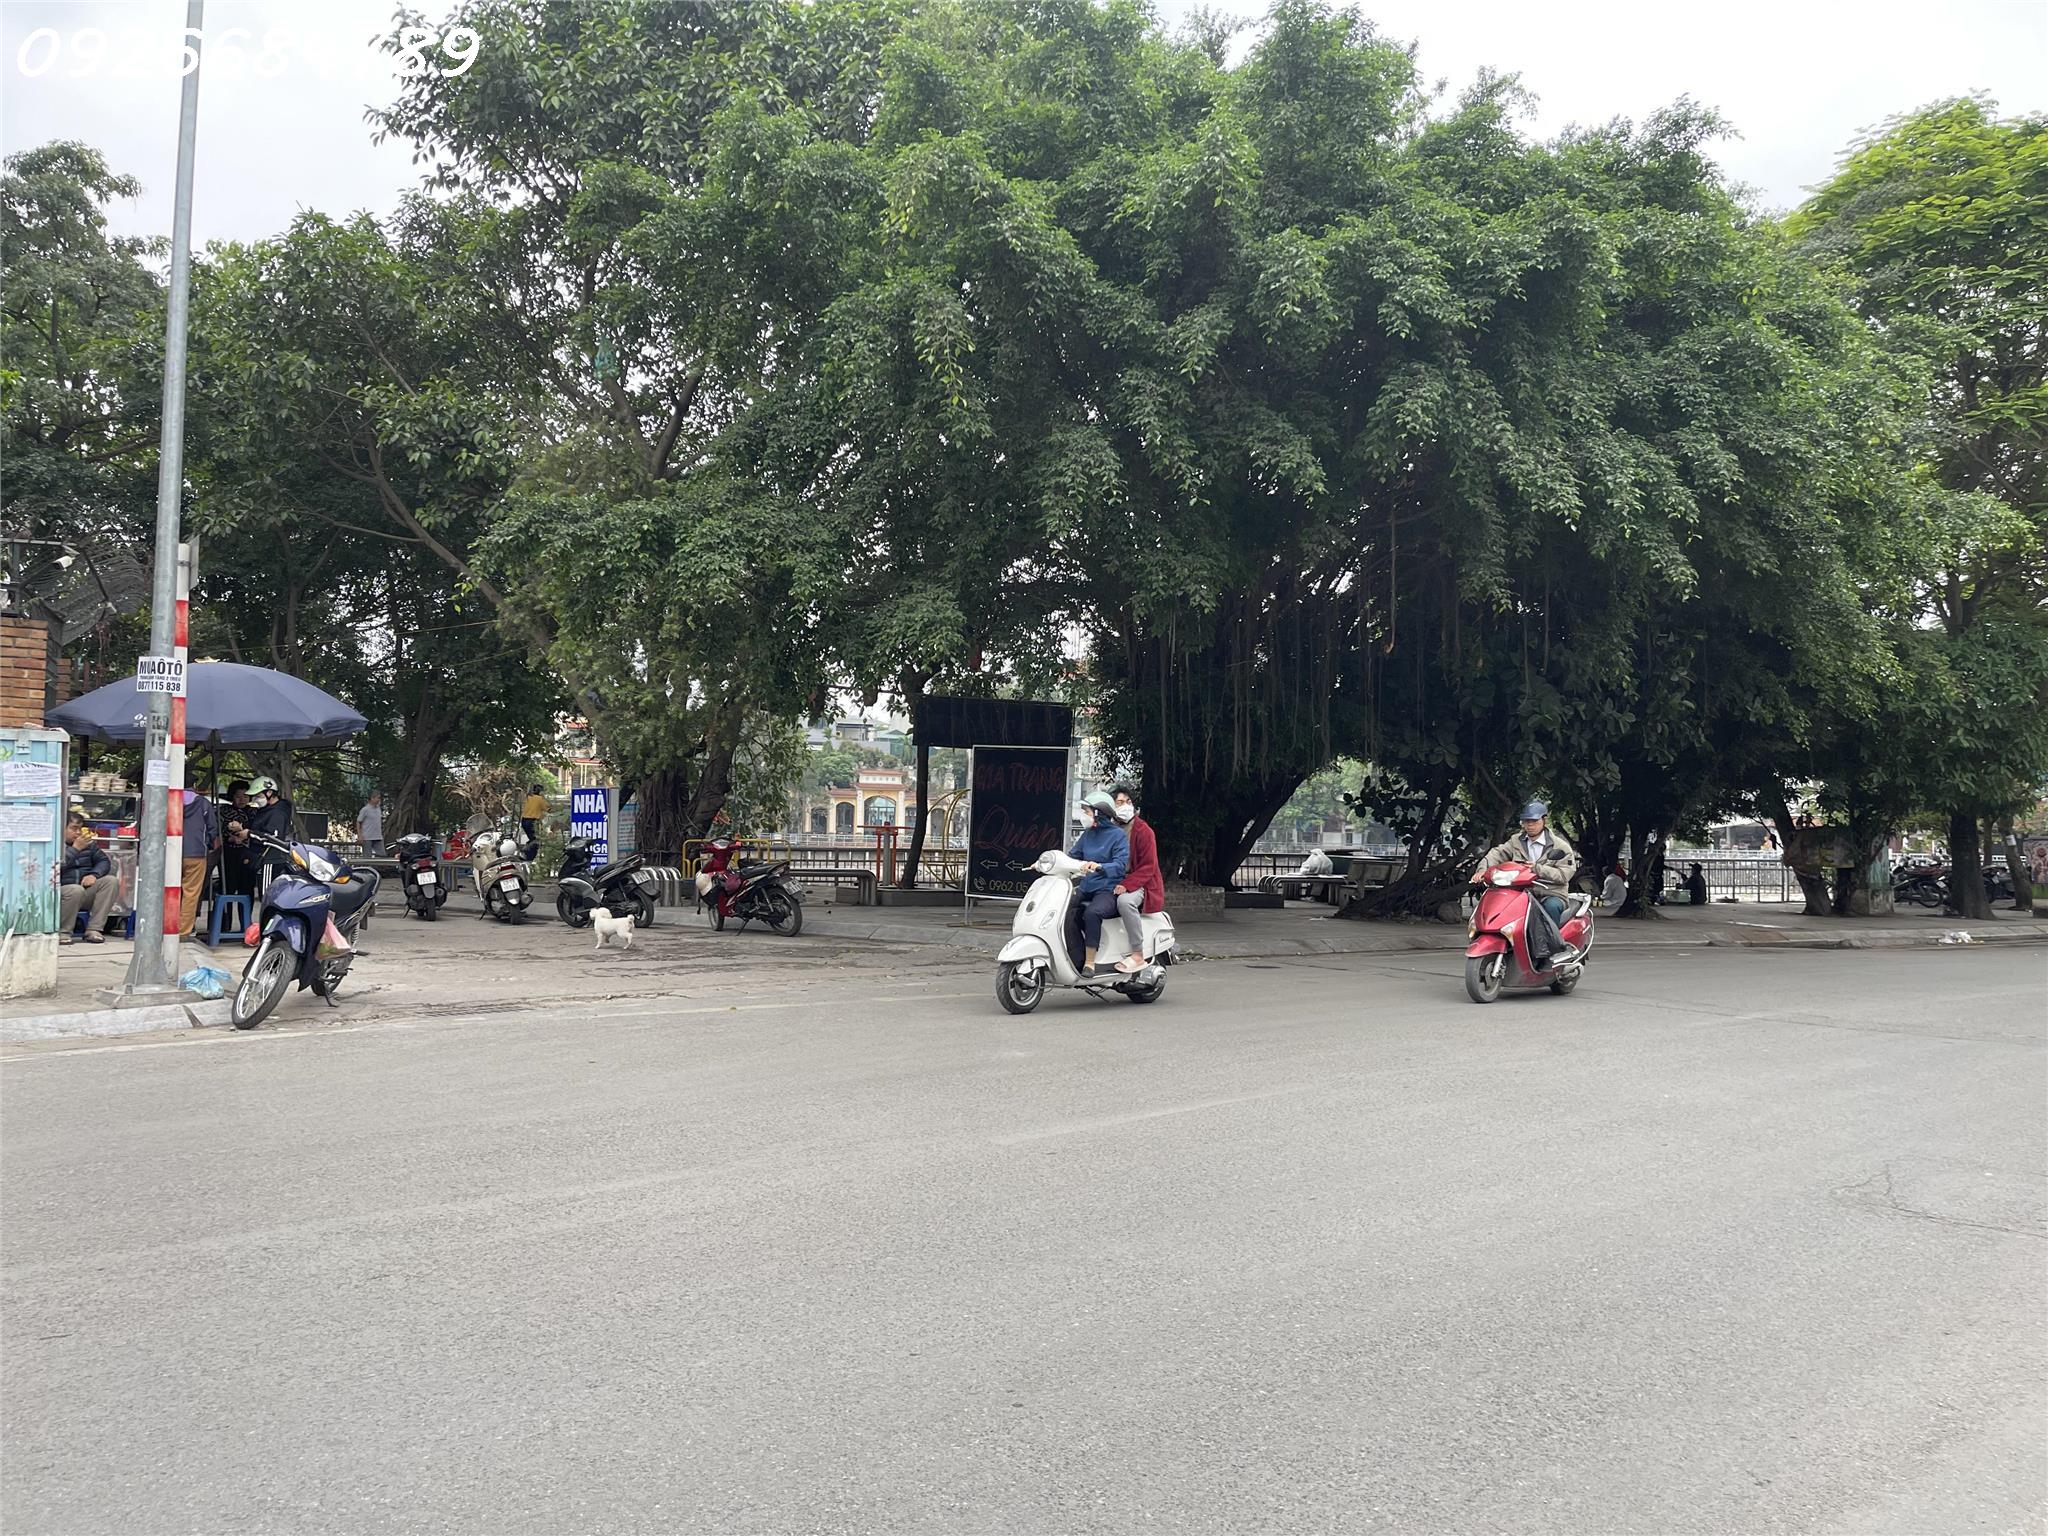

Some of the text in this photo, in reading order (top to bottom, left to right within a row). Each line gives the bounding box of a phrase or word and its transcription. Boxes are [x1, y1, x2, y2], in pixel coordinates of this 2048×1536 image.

[166, 682, 181, 692] 838
[573, 790, 606, 813] NHÀ
[571, 814, 609, 841] NGHỈ
[974, 804, 1060, 859] Quán
[989, 879, 1014, 892] 0962
